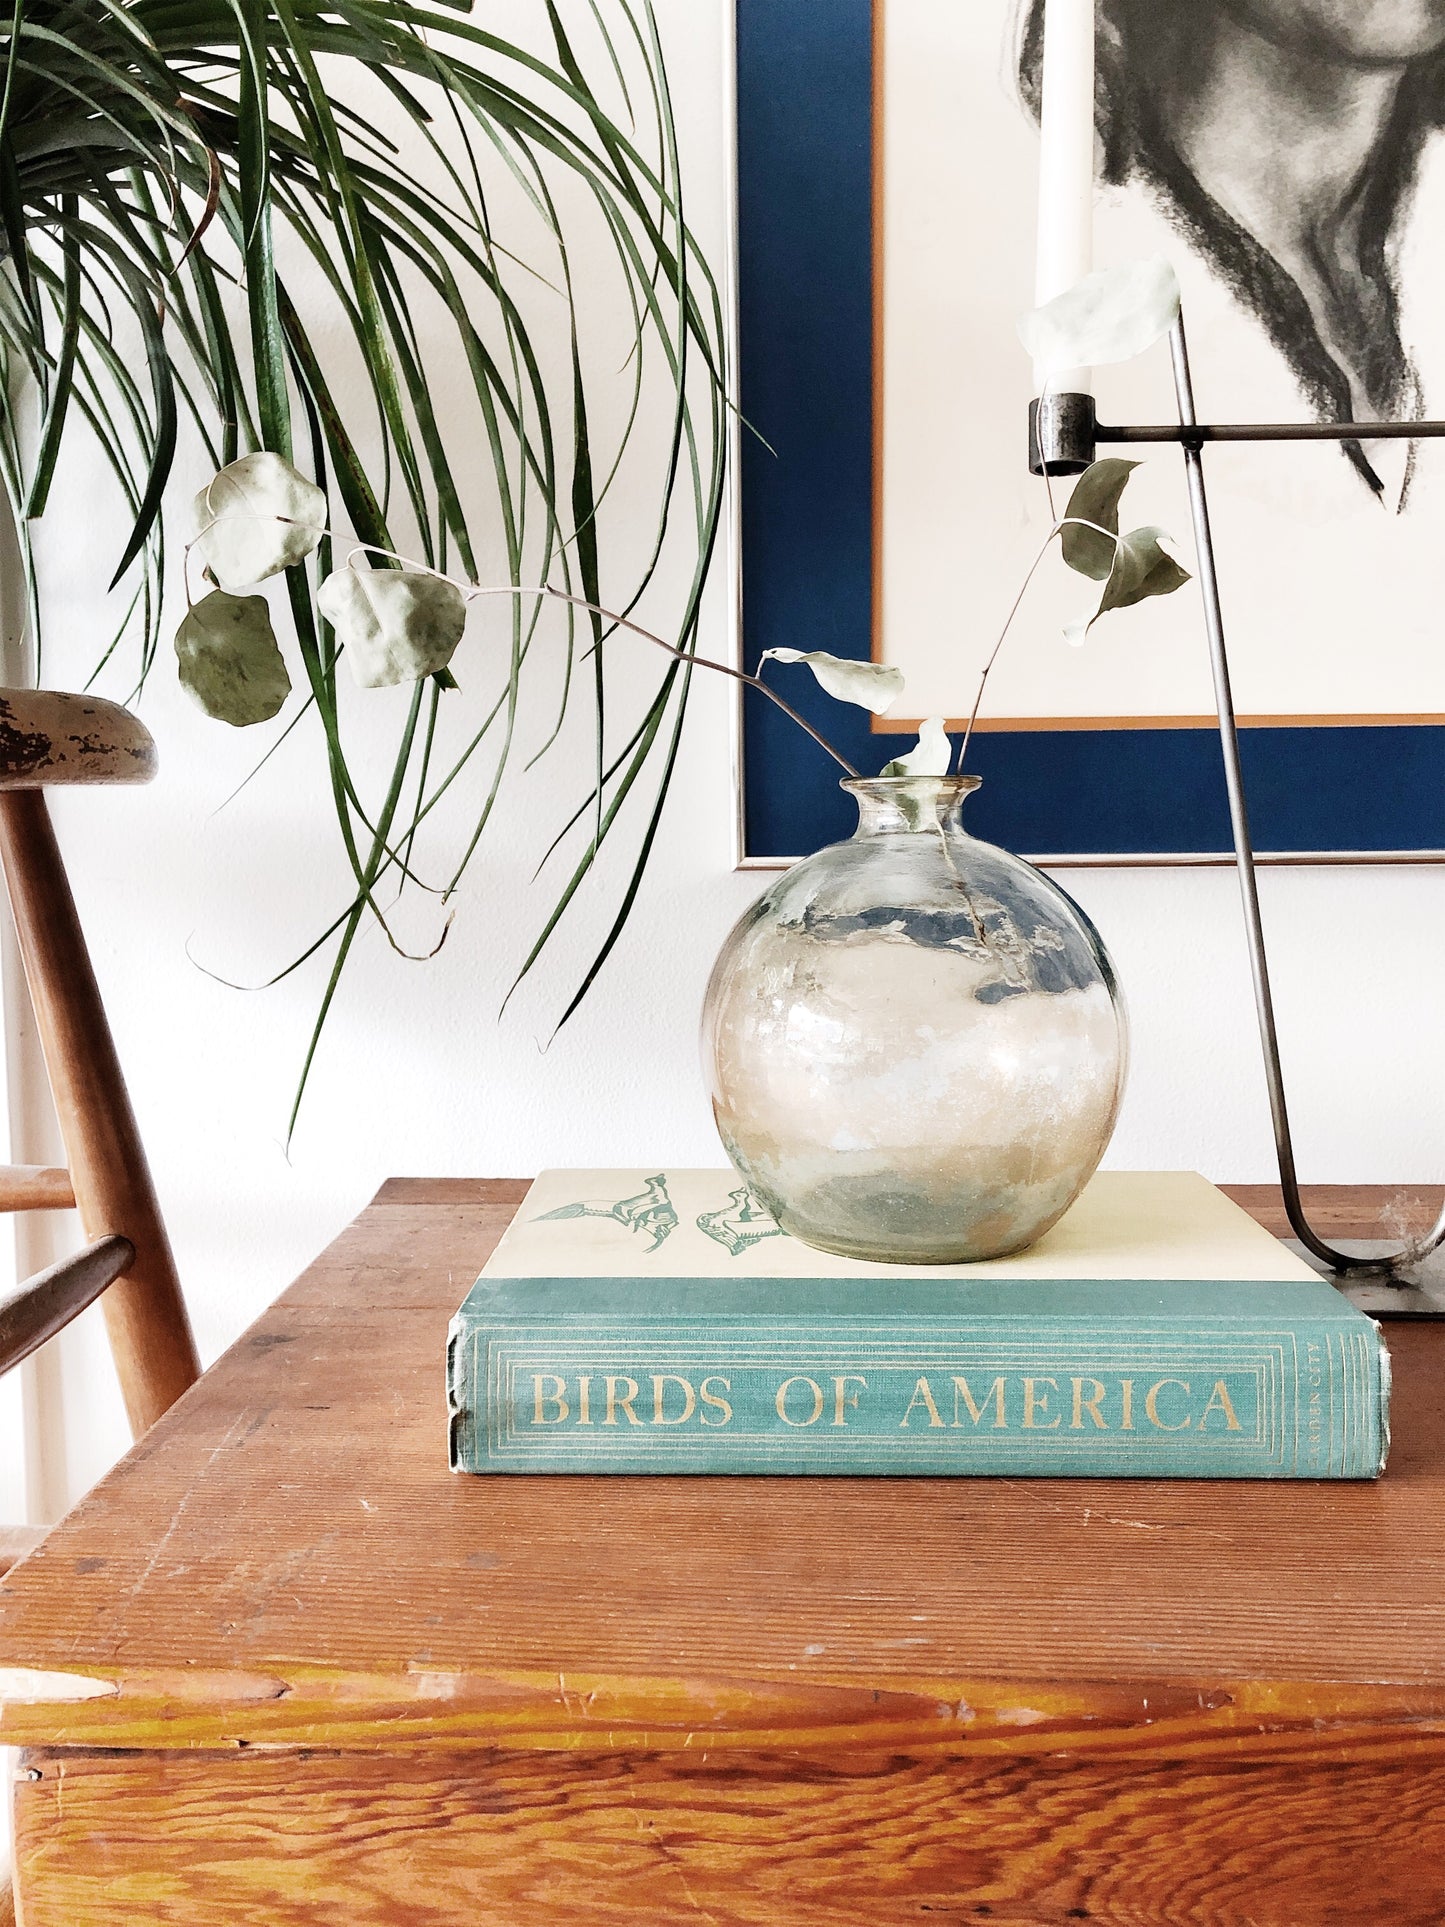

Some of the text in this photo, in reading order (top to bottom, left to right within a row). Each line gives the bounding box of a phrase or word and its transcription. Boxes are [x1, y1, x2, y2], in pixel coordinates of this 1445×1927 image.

[1307, 1342, 1321, 1387] CITY
[530, 1374, 1243, 1431] BIRDS OF AMERICA
